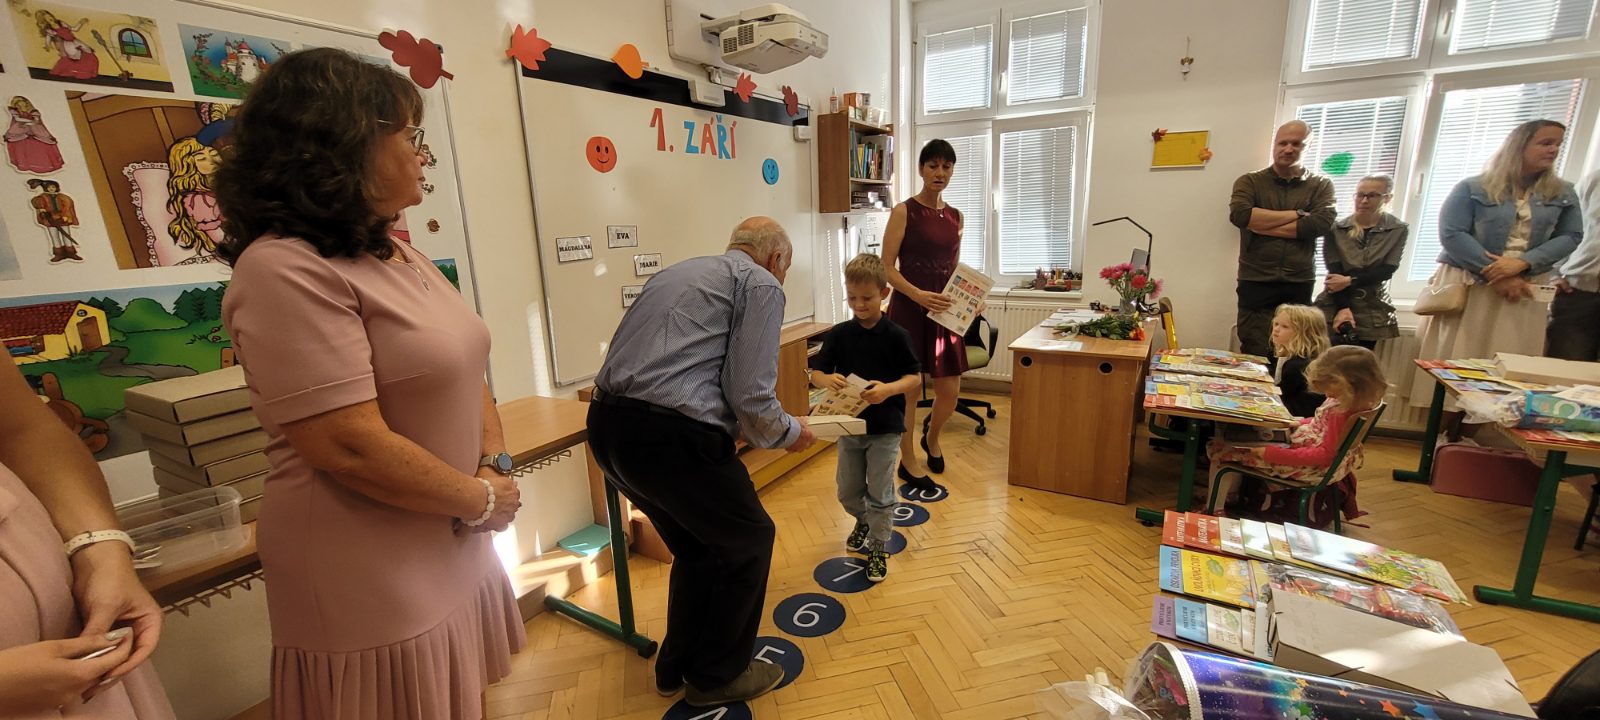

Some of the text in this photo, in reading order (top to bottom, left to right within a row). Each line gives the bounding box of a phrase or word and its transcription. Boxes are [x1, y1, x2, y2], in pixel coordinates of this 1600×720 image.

[649, 107, 737, 159] 1. ZÁŘÍ
[616, 232, 630, 240] EVA
[892, 506, 914, 520] 9
[832, 562, 865, 582] 7
[792, 602, 827, 628] 6
